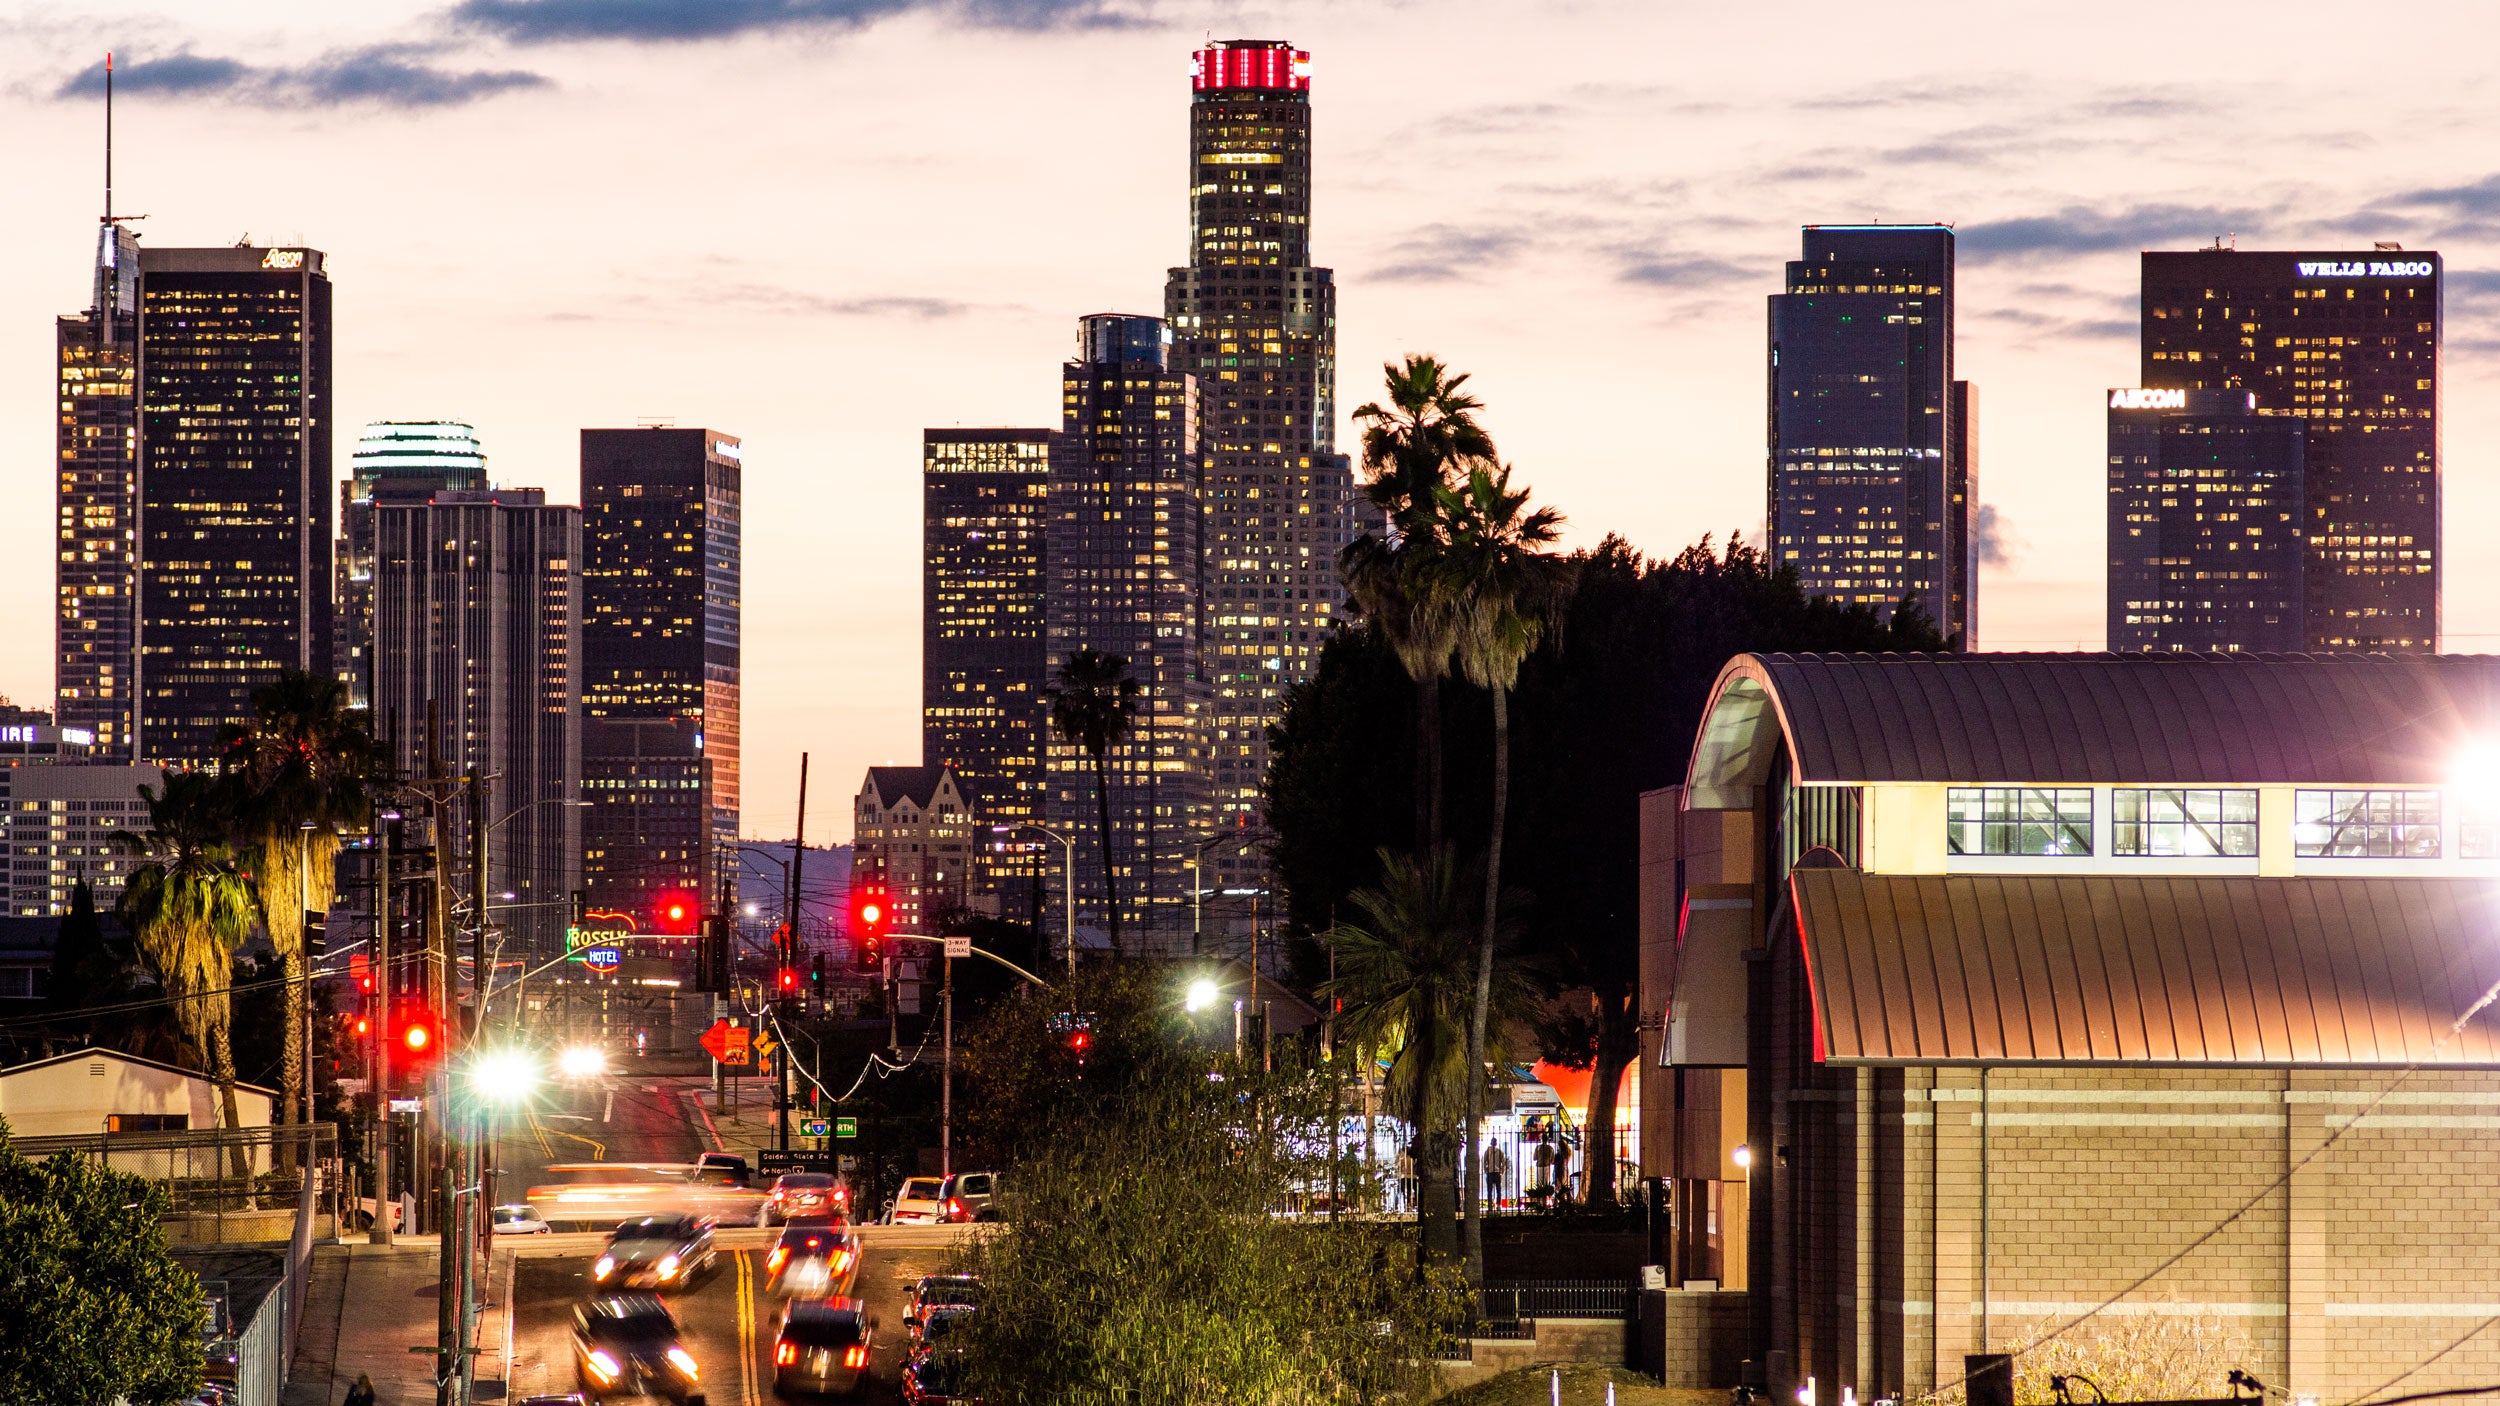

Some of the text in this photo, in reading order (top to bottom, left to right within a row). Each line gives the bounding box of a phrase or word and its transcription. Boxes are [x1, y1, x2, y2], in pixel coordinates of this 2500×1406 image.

[2298, 261, 2433, 276] WELLS FARGO
[2110, 388, 2186, 409] AECOM
[589, 950, 618, 963] HOTEL
[827, 1123, 854, 1132] NRTH
[771, 1167, 792, 1175] North
